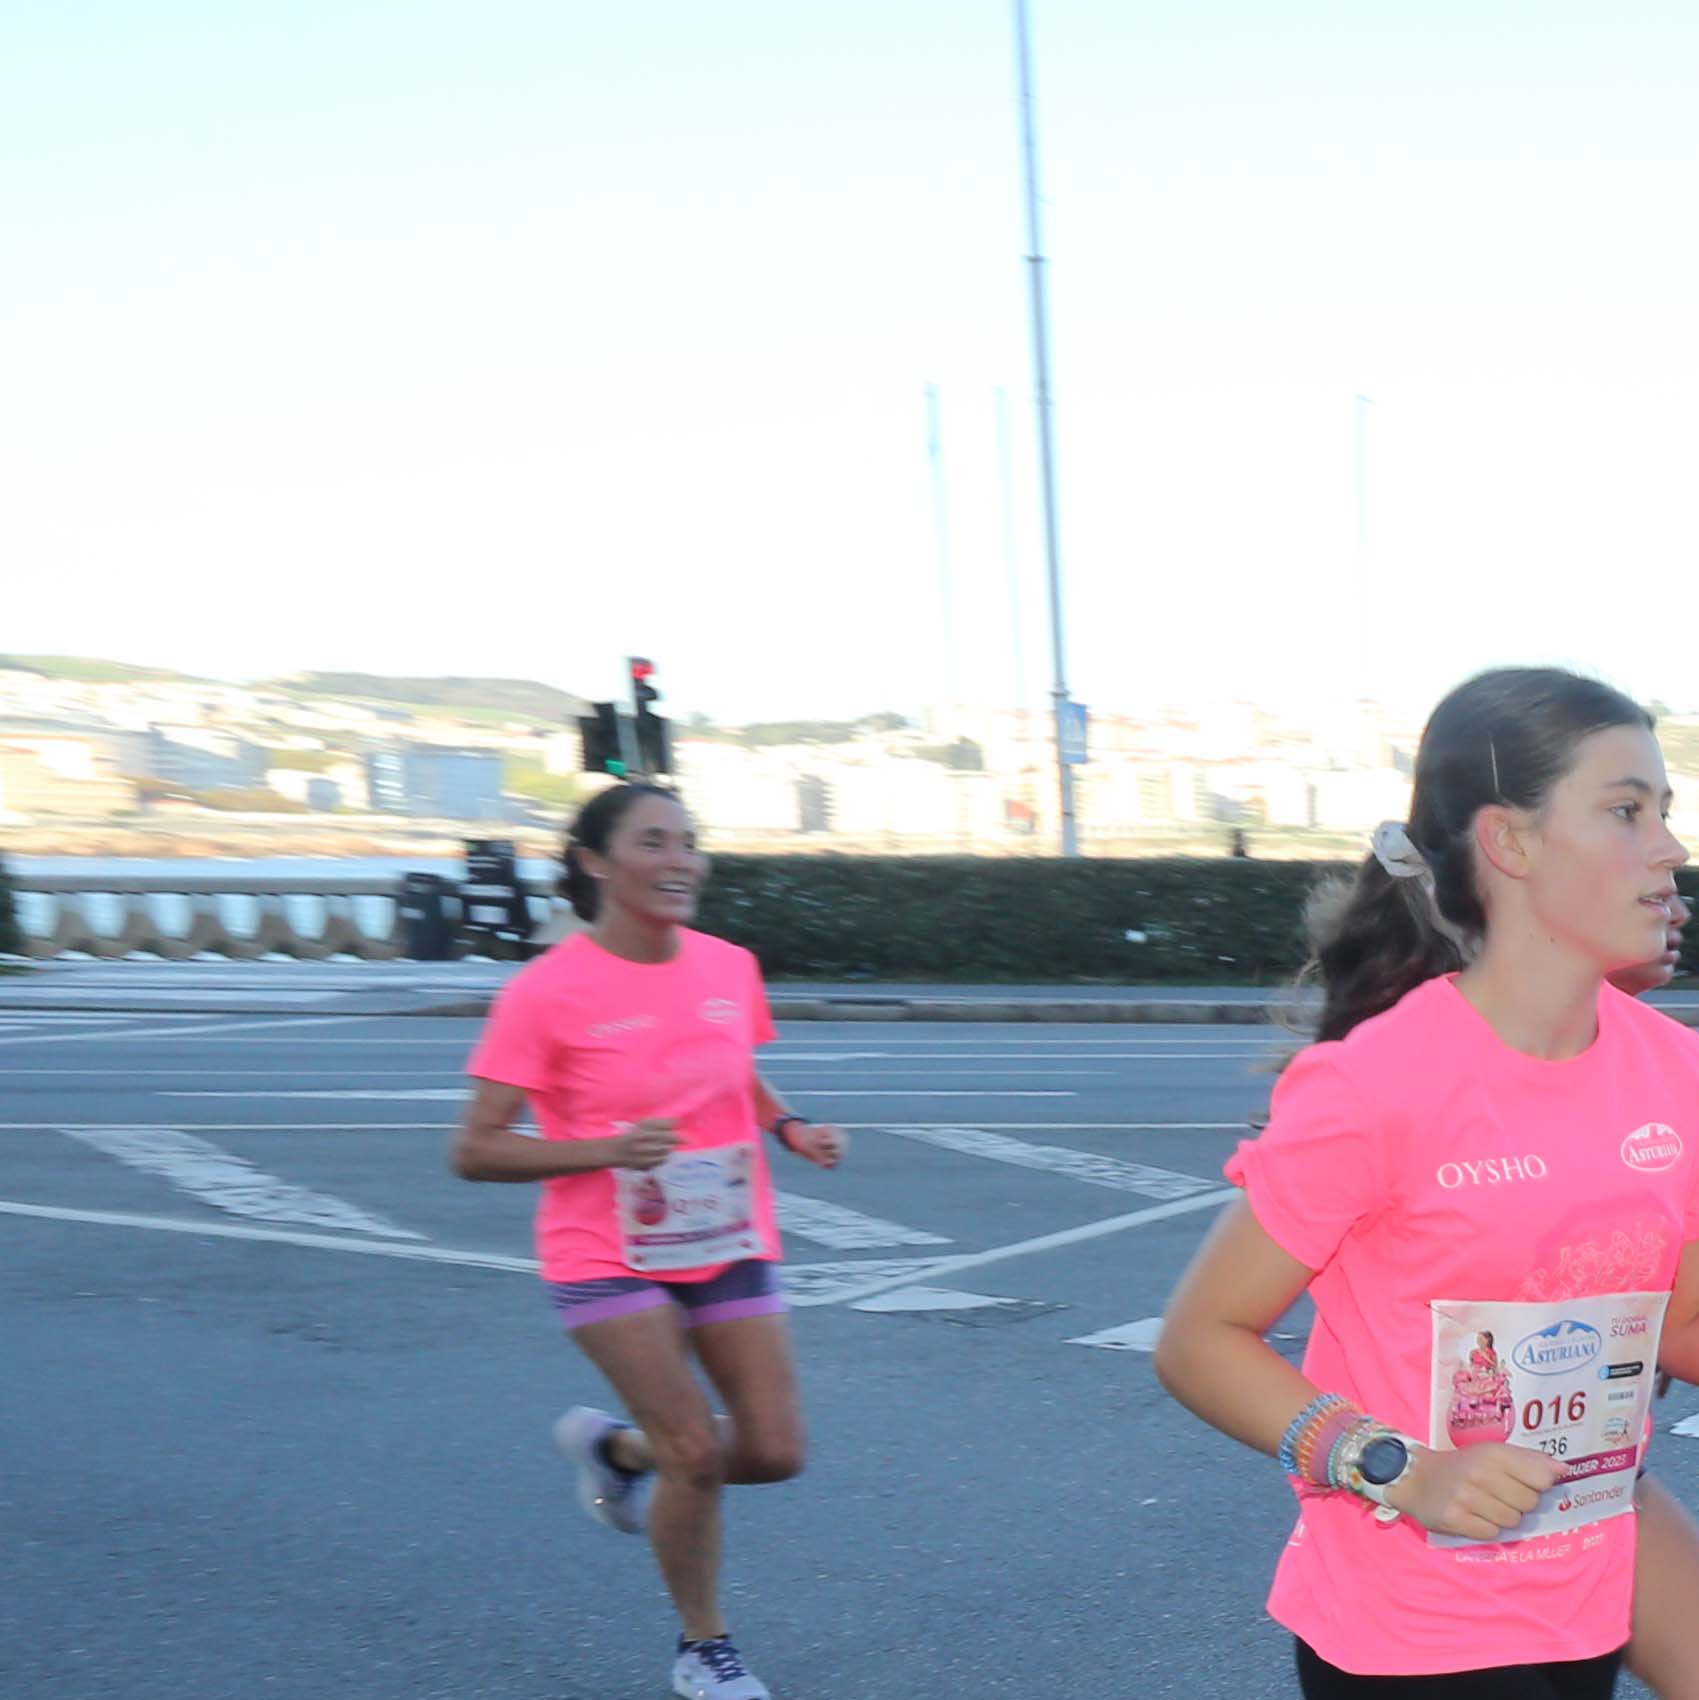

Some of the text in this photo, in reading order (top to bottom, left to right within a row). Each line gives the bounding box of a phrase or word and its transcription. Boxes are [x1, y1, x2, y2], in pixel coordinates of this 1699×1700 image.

[1437, 1154, 1548, 1189] OYSHO
[1610, 1323, 1646, 1338] SUMA
[1521, 1341, 1598, 1367] ASTURIANA
[1522, 1391, 1586, 1431] 016
[1573, 1485, 1624, 1509] Santander
